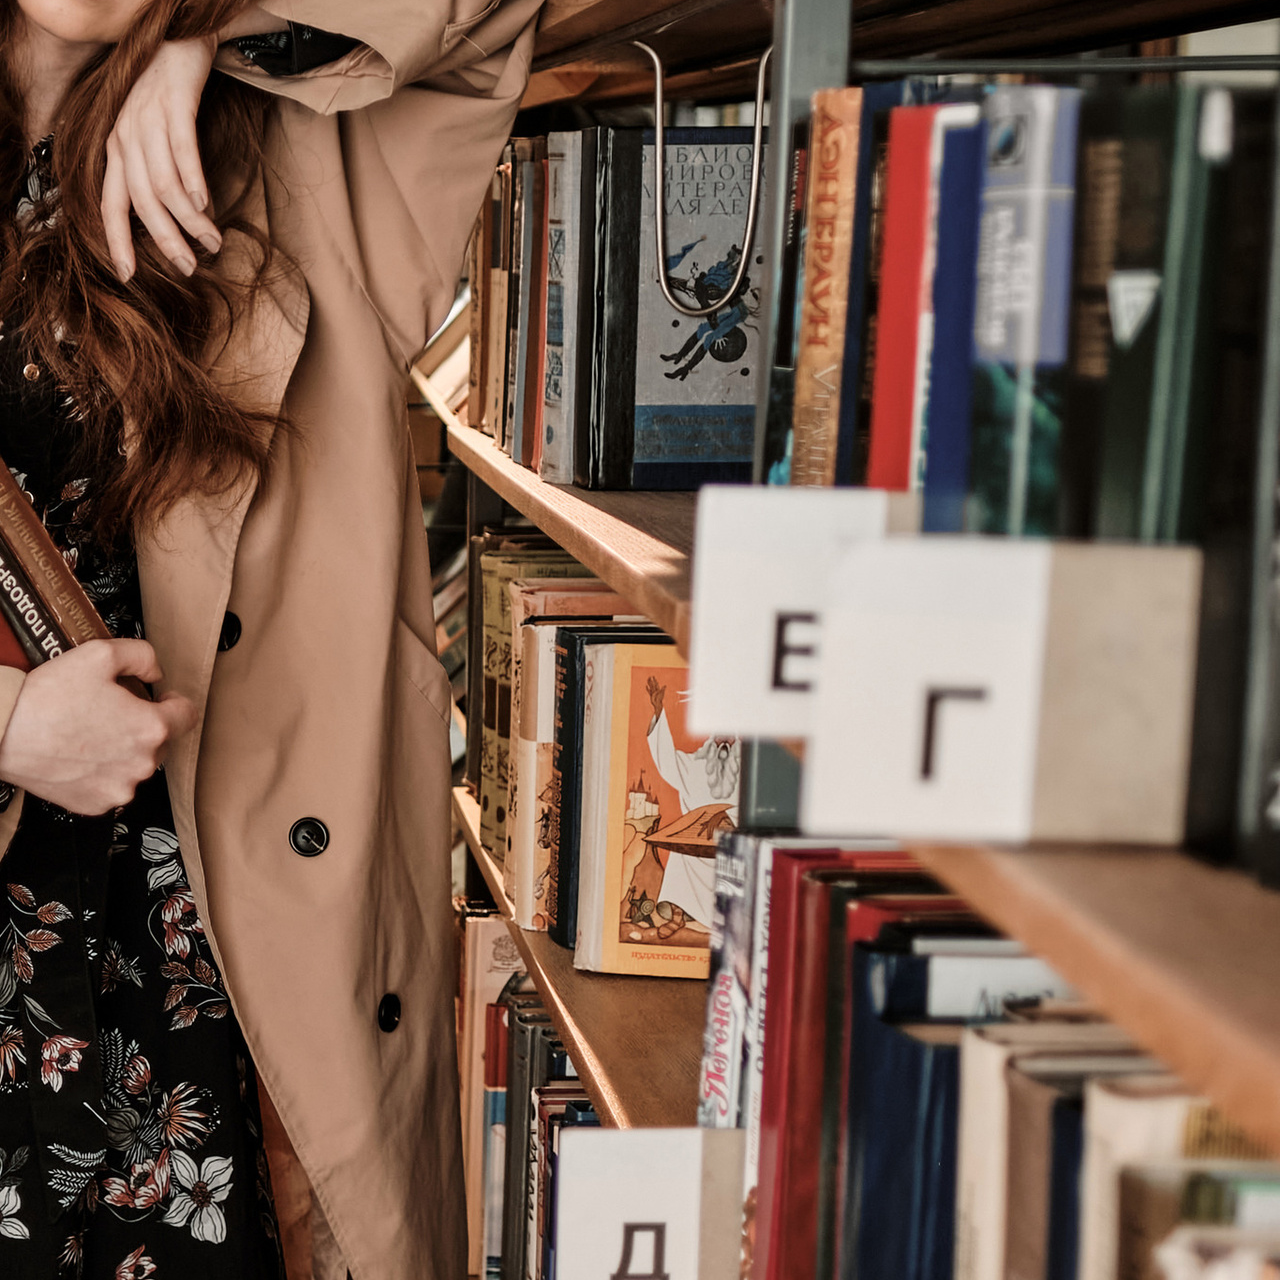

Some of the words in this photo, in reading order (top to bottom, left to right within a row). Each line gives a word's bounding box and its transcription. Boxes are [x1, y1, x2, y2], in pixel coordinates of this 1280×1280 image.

[2, 501, 65, 591] ПРОТИВНИК
[40, 631, 65, 661] ОД
[769, 610, 818, 692] Е
[918, 685, 988, 783] Г
